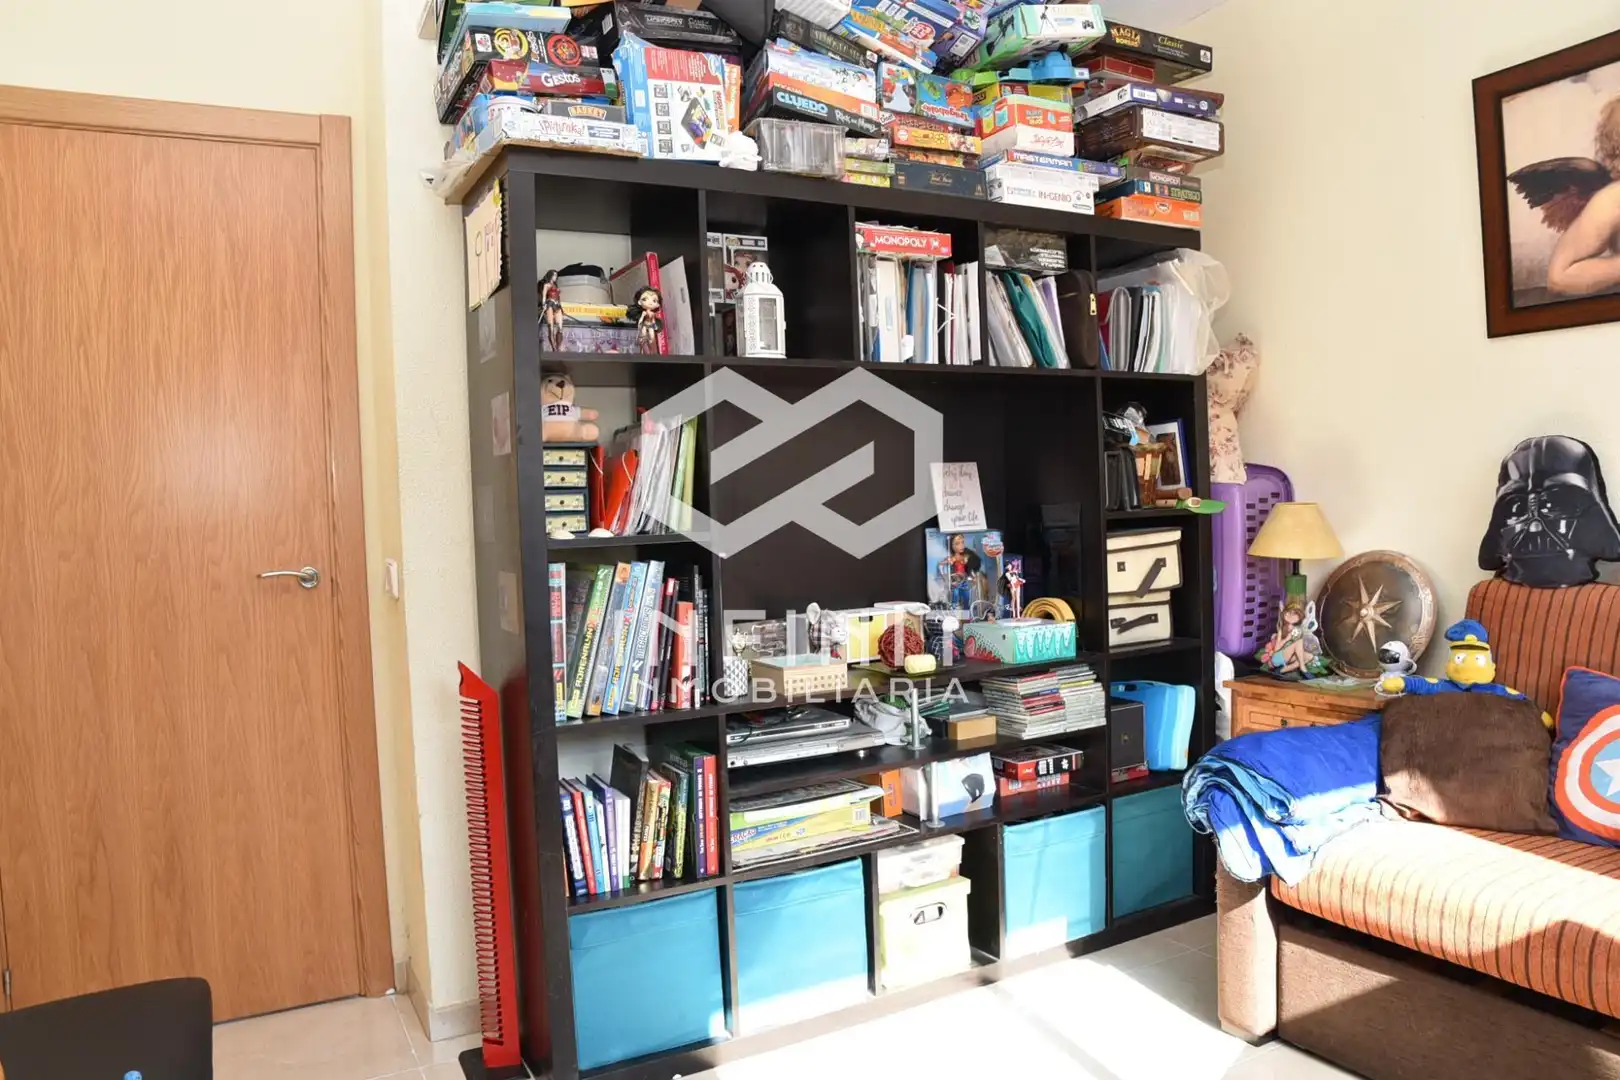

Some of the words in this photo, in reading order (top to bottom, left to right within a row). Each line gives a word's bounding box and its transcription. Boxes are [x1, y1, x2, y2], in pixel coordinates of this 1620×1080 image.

[1111, 27, 1141, 43] MAGIA
[1158, 35, 1185, 49] Classic
[776, 91, 829, 114] CLUEDO
[874, 235, 928, 249] MONOPOLY
[547, 404, 570, 416] EIP
